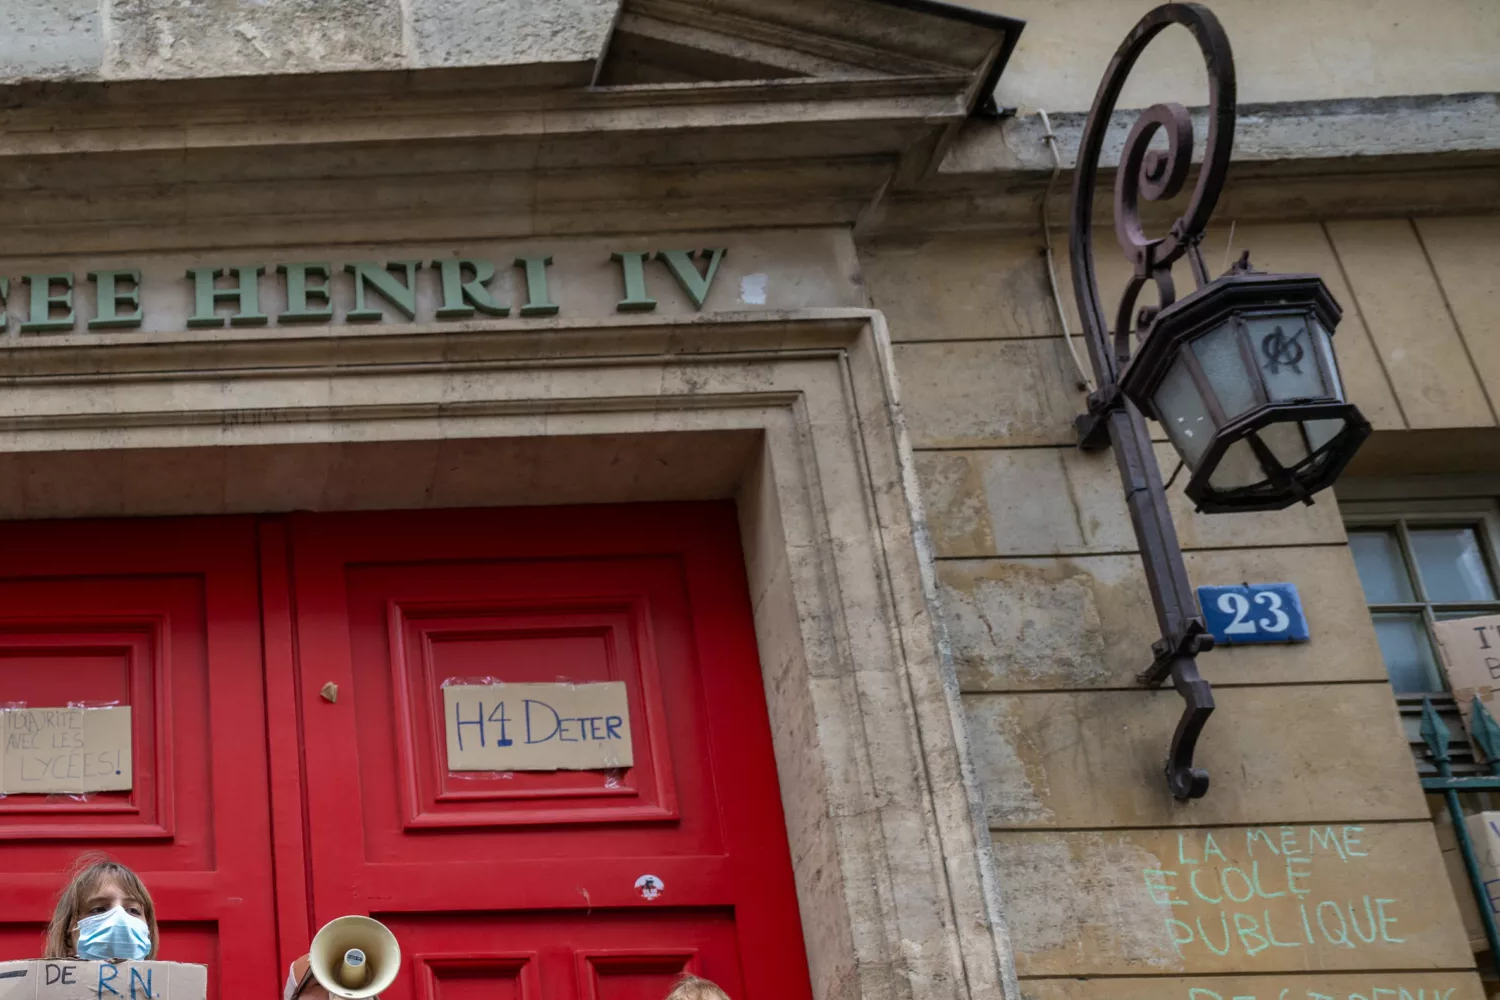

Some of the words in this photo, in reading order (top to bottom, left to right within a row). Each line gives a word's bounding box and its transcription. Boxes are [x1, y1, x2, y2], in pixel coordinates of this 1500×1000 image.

[186, 255, 560, 329] HENRI
[610, 247, 728, 312] IV
[1217, 591, 1290, 635] 23
[5, 732, 41, 754] AVEC
[52, 732, 84, 749] LES
[1178, 833, 1227, 864] LA
[45, 964, 77, 986] DE
